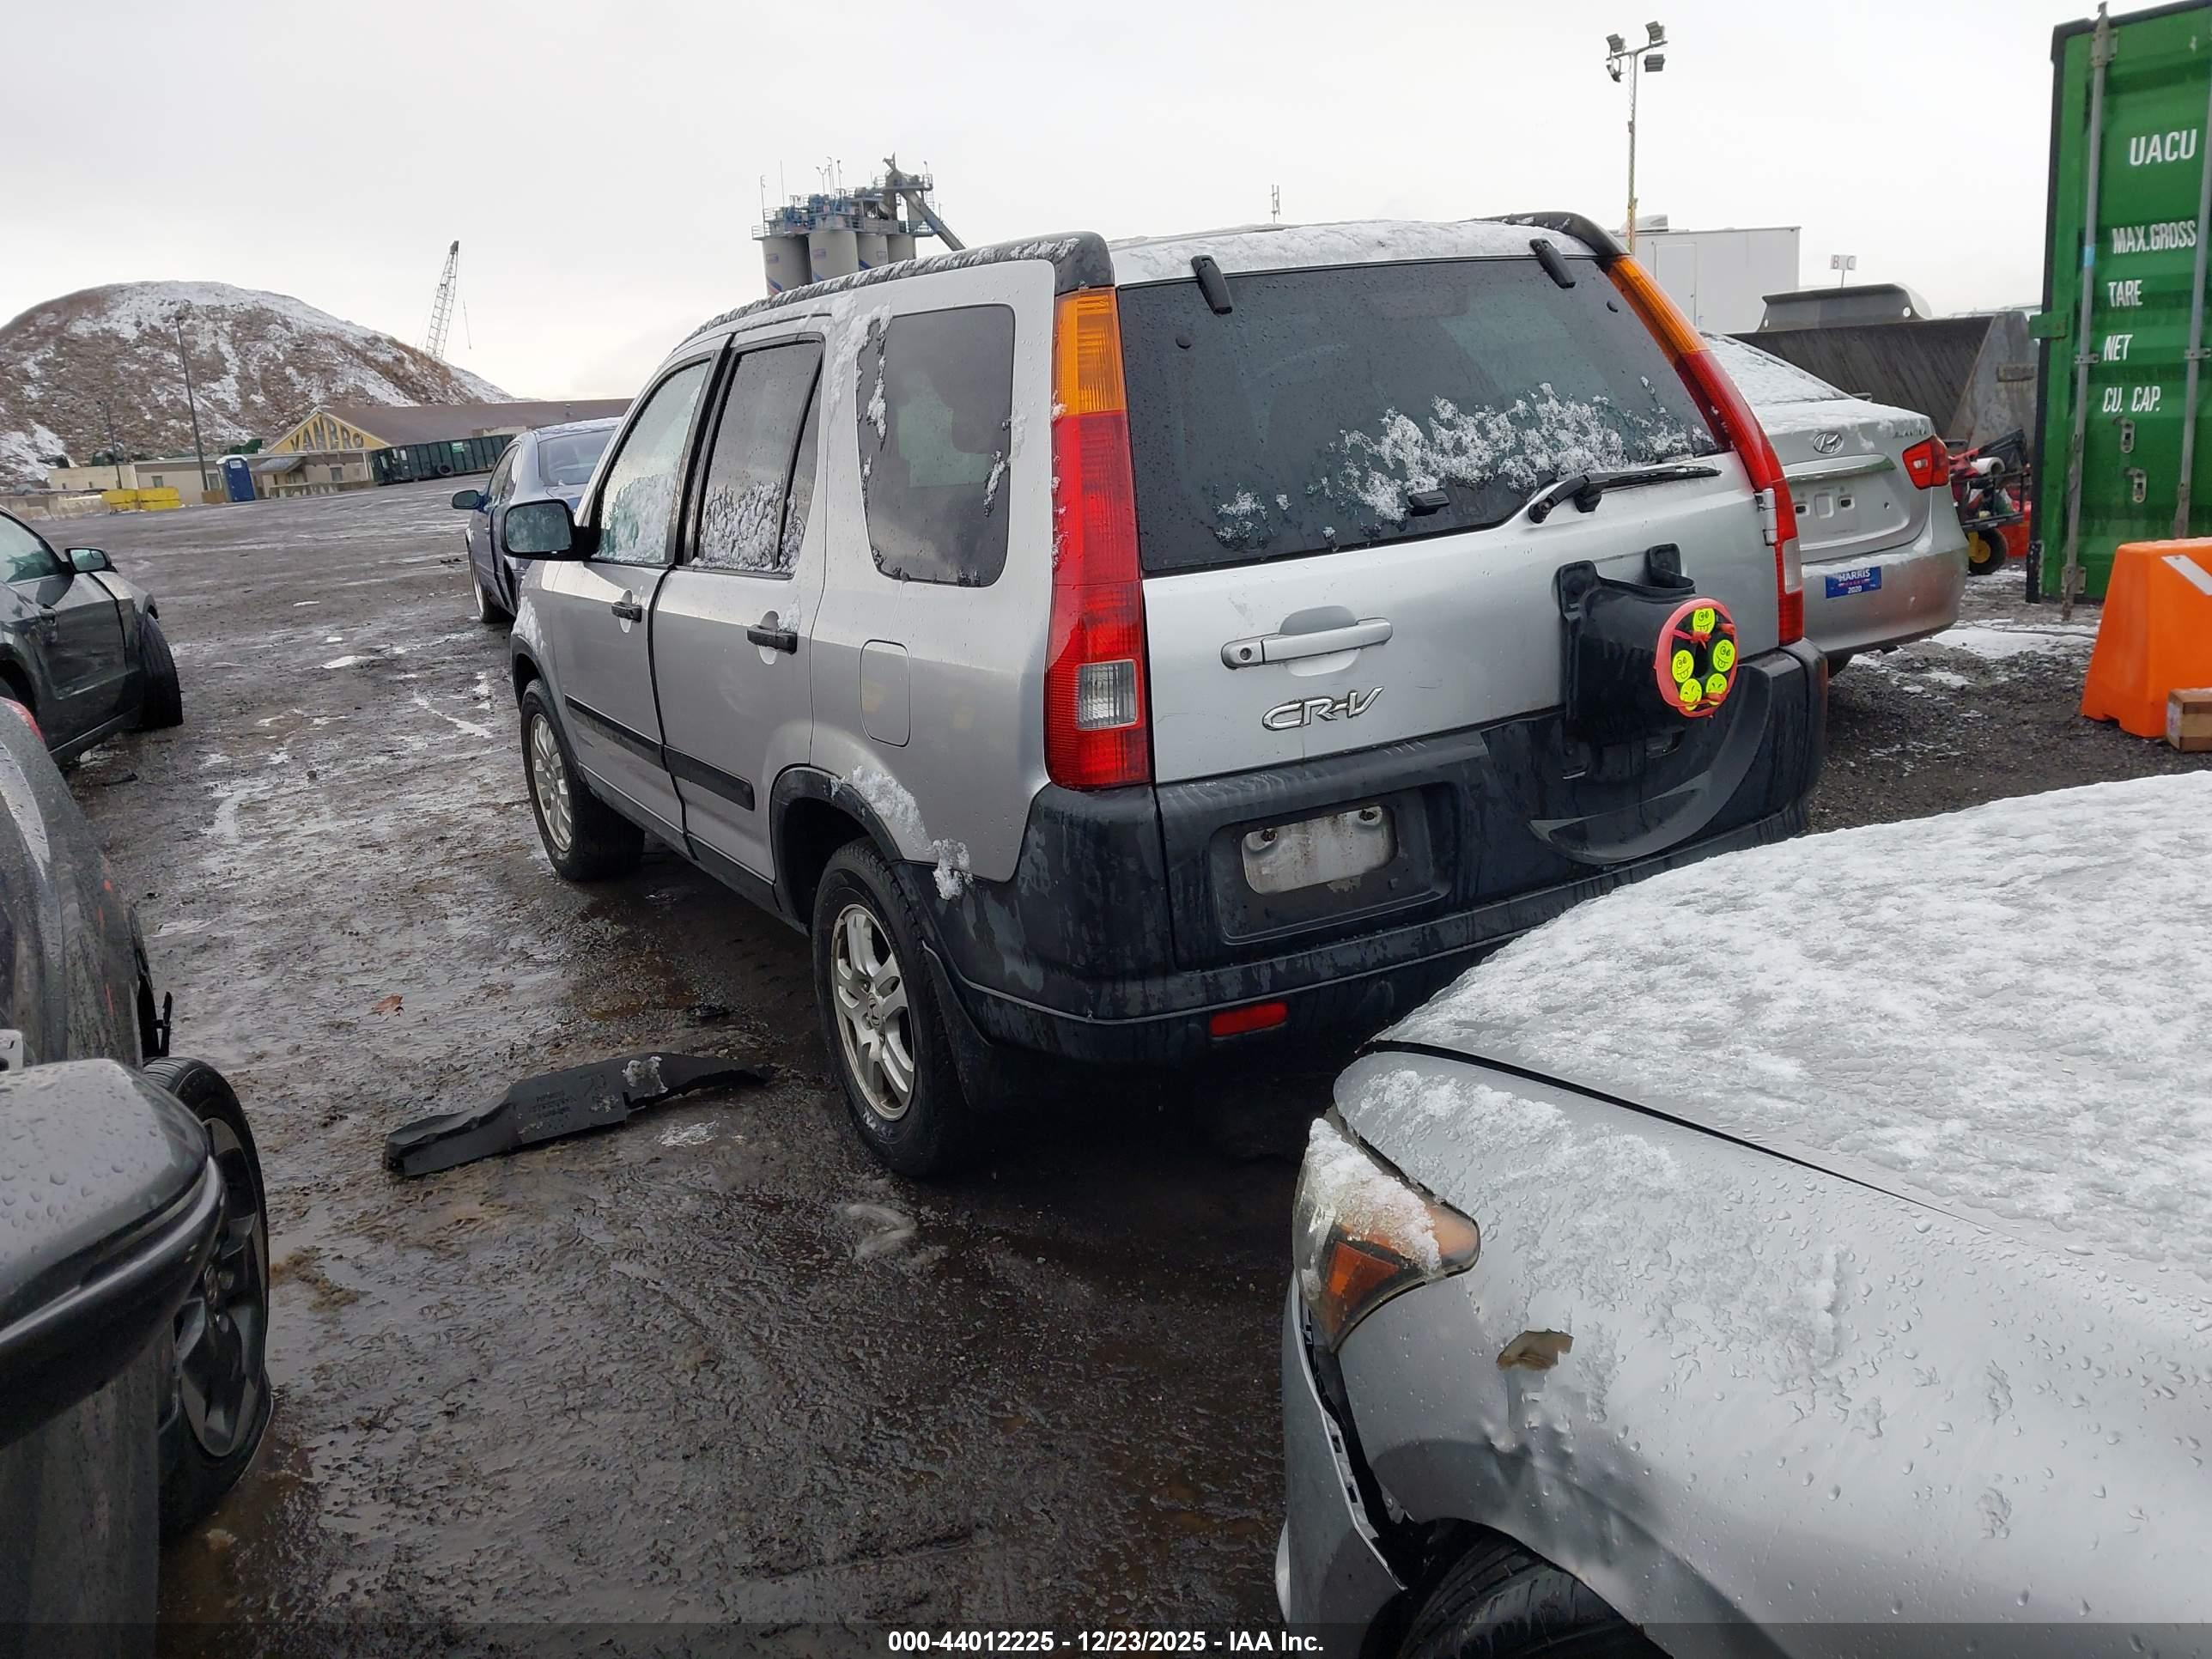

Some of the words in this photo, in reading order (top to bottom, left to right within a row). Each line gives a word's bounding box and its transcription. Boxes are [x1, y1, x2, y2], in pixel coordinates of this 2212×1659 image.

[2129, 128, 2197, 167] UACU
[2107, 279, 2143, 307] TARE
[2103, 333, 2134, 362] NET
[2101, 386, 2124, 413] CU.
[2130, 386, 2161, 412] CAP.
[1838, 568, 1871, 582] HARRIS
[1262, 686, 1384, 731] CR-V
